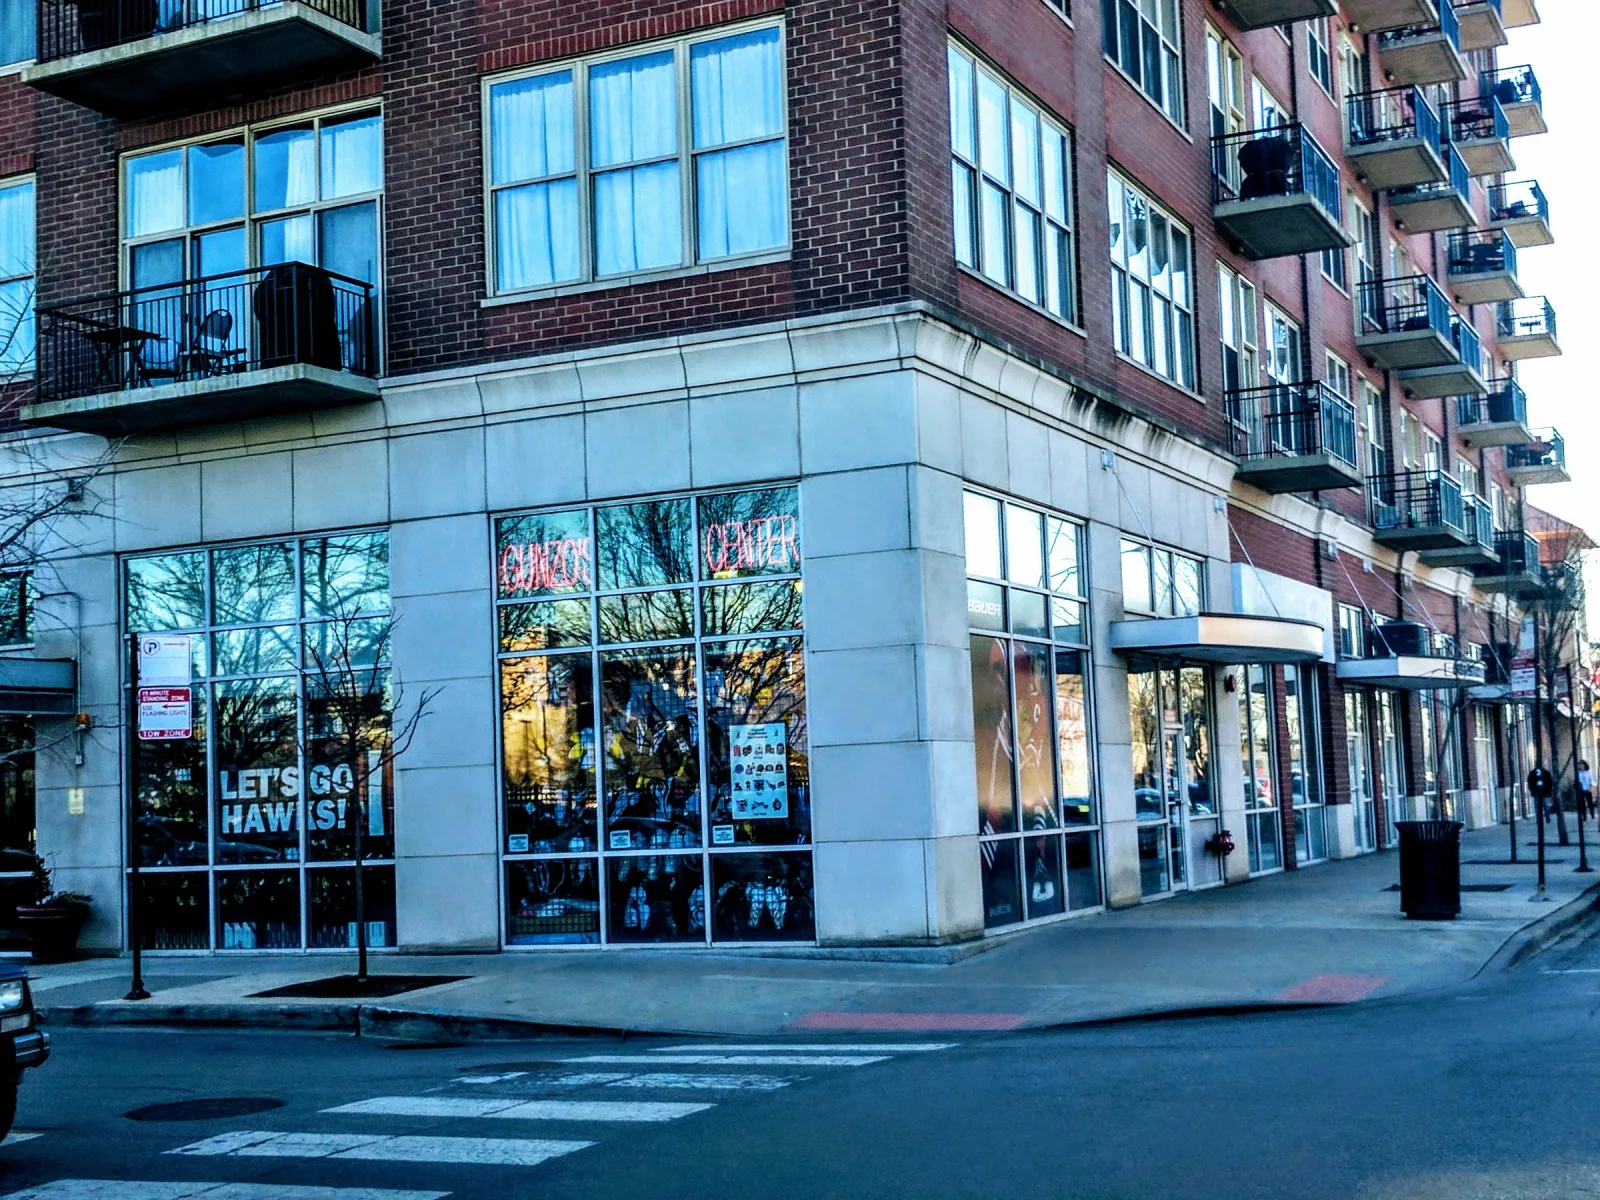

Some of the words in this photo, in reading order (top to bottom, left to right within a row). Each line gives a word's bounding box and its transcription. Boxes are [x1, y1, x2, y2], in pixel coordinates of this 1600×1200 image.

[706, 514, 800, 572] CENTER
[219, 766, 299, 800] LET'S
[310, 763, 354, 795] GO
[222, 798, 347, 834] HAWKS!
